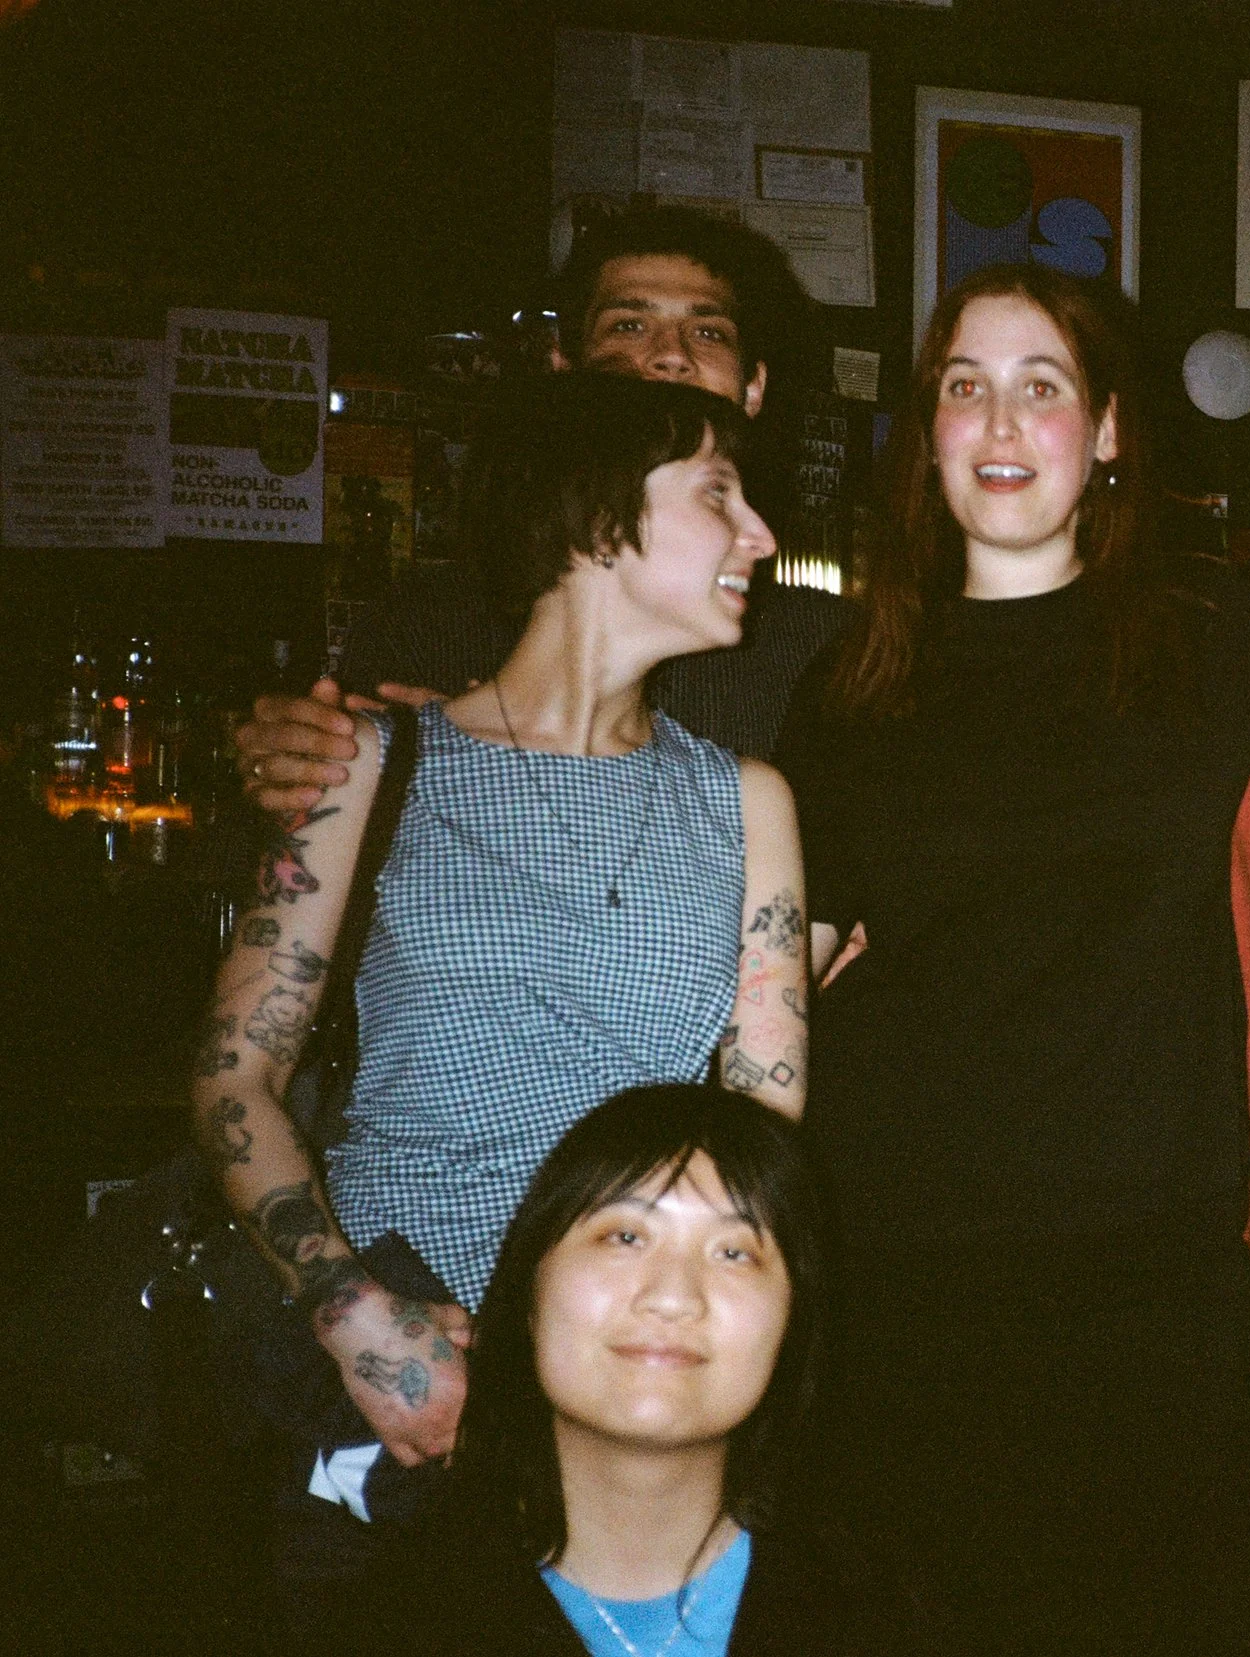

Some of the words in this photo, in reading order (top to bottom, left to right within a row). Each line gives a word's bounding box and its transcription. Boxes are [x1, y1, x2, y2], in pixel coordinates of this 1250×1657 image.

[172, 473, 284, 493] ALCOHOLIC
[171, 491, 250, 509] MATCHA
[257, 495, 310, 512] SODA
